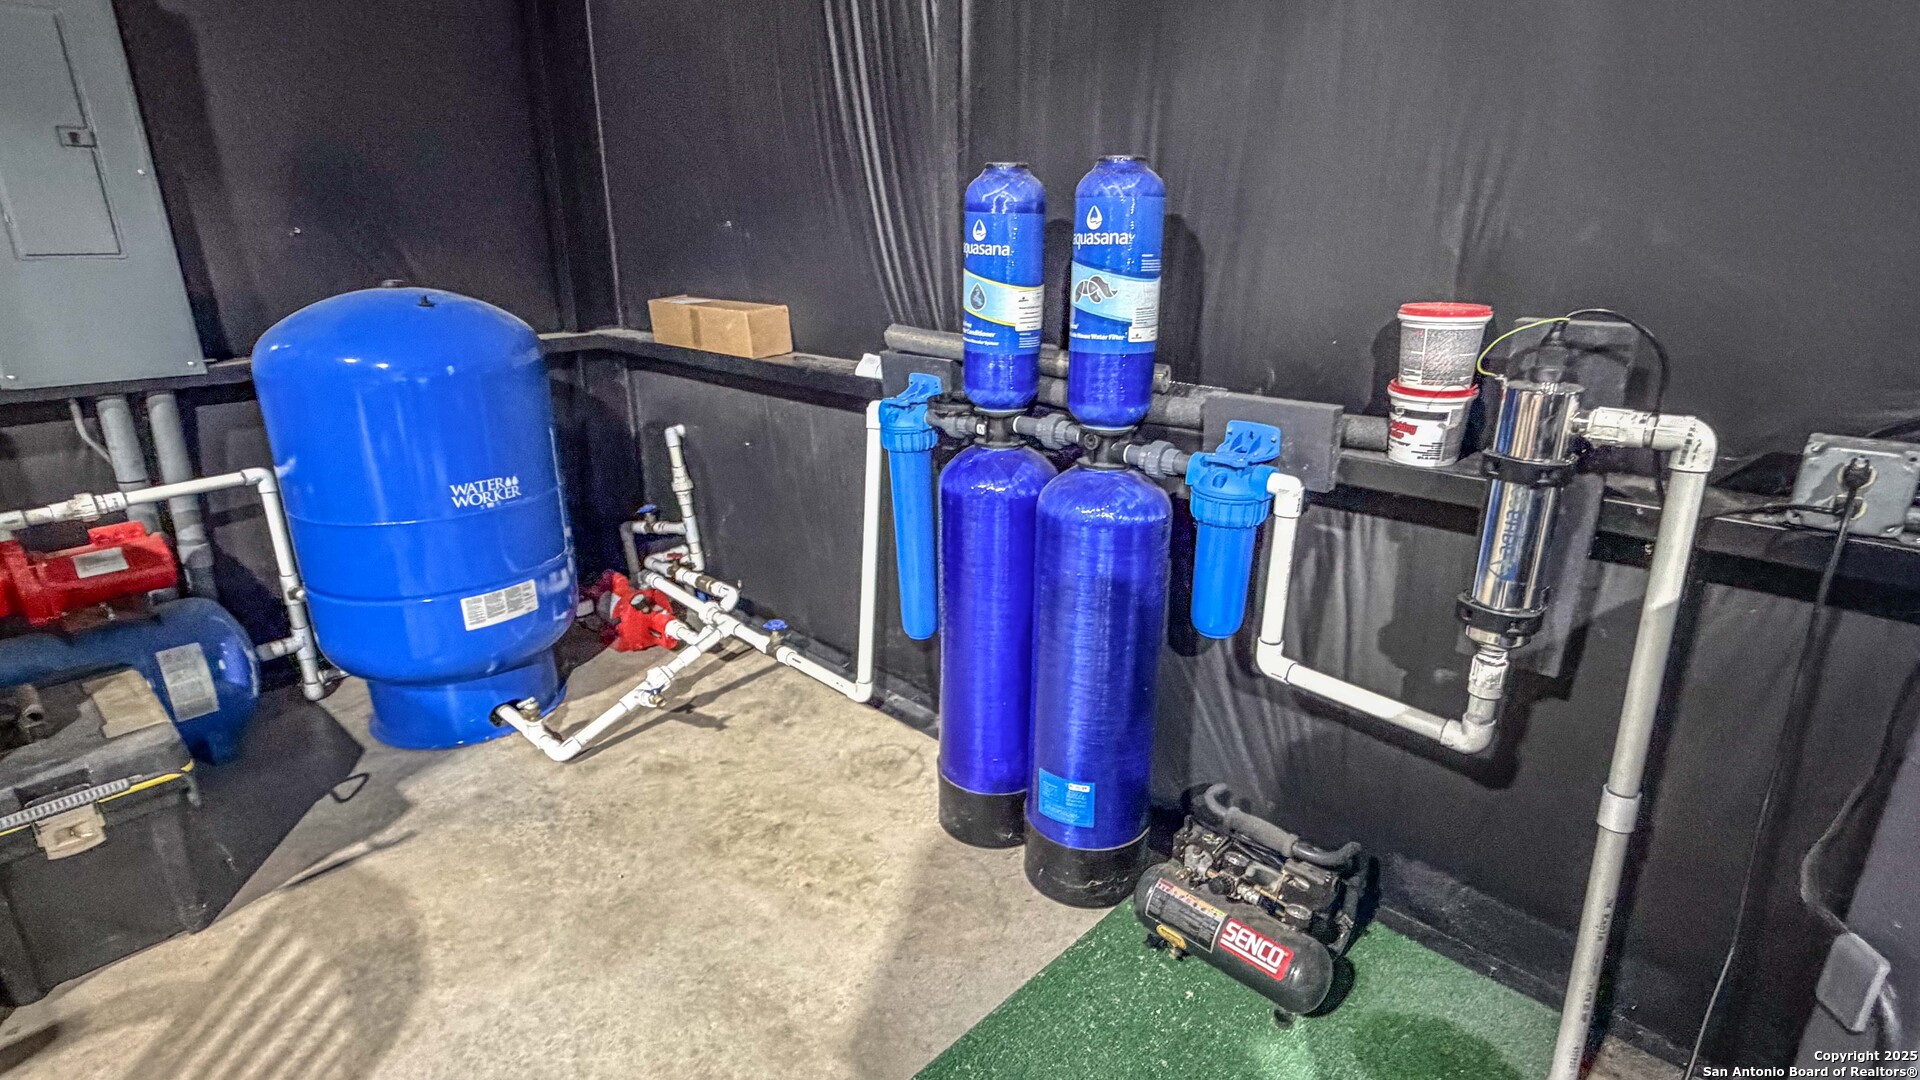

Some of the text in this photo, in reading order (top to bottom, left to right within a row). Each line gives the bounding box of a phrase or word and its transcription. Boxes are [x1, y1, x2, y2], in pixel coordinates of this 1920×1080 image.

[449, 477, 506, 496] WATER
[451, 485, 521, 508] WORKER
[1222, 921, 1285, 968] SENCO
